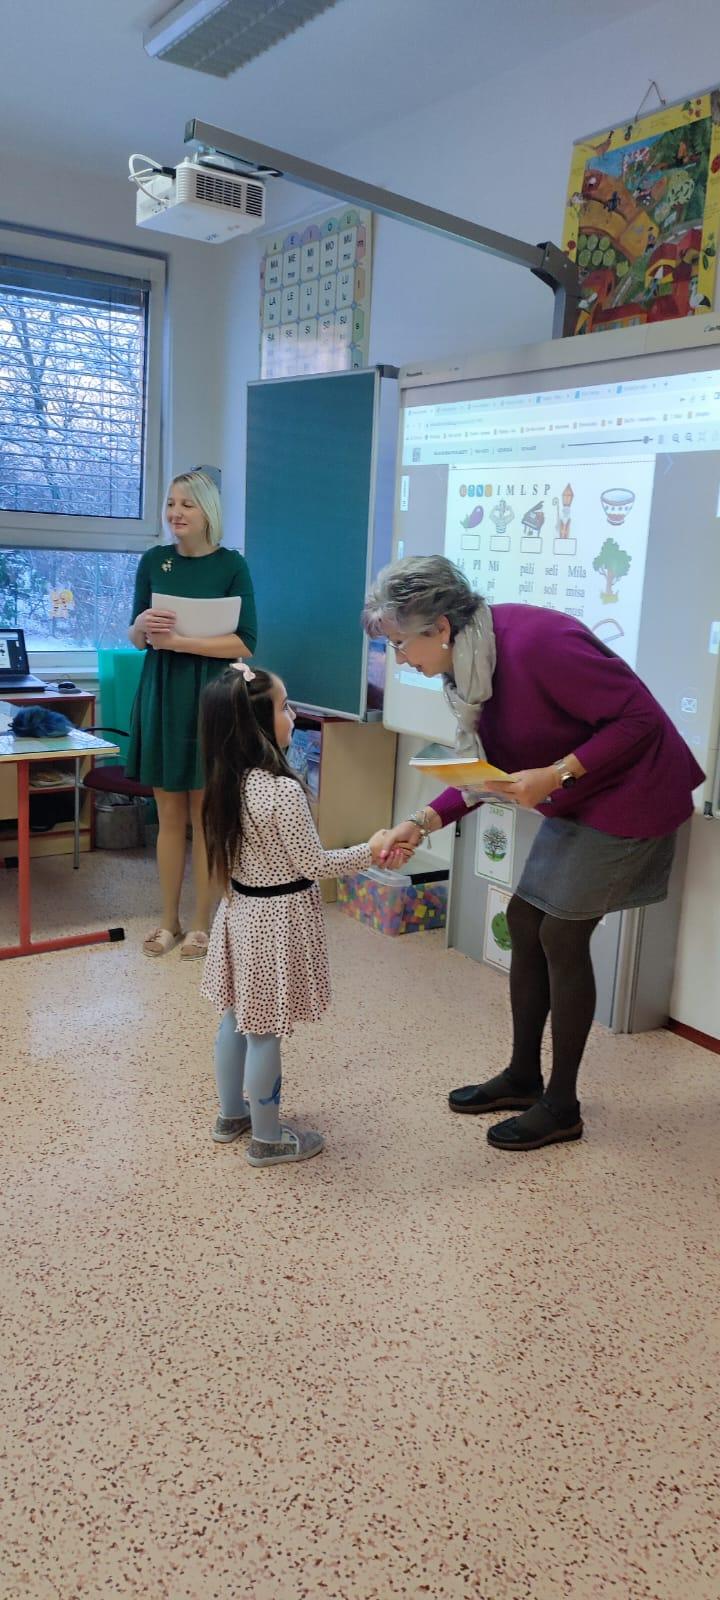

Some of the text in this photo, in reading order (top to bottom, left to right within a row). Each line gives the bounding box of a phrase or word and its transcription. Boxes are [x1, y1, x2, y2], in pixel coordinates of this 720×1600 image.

[506, 484, 514, 496] M
[520, 484, 526, 496] L
[532, 484, 538, 496] S
[544, 484, 550, 496] P
